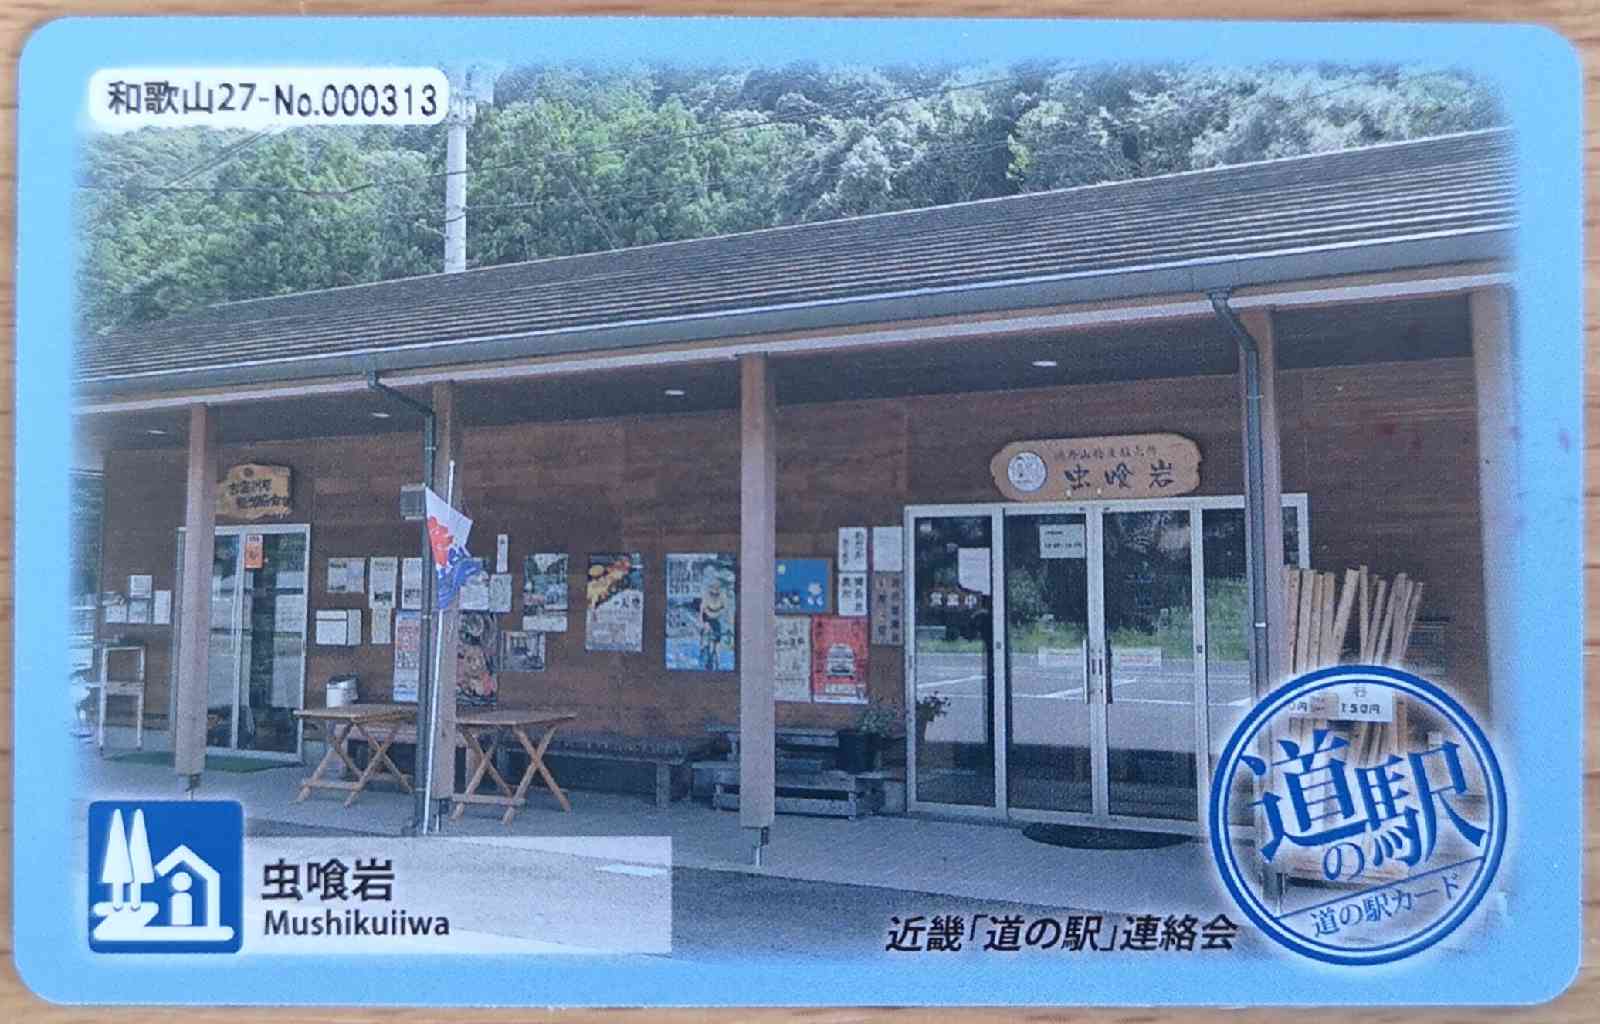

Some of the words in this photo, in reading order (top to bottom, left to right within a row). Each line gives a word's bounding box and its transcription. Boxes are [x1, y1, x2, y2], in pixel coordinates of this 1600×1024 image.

[1239, 728, 1488, 881] 道の駅
[261, 858, 394, 902] 虫喰岩
[264, 908, 450, 937] Mushikuiiwa
[1312, 873, 1463, 937] 道の駅カード
[886, 914, 1238, 952] 近畿「道の駅」連絡会
